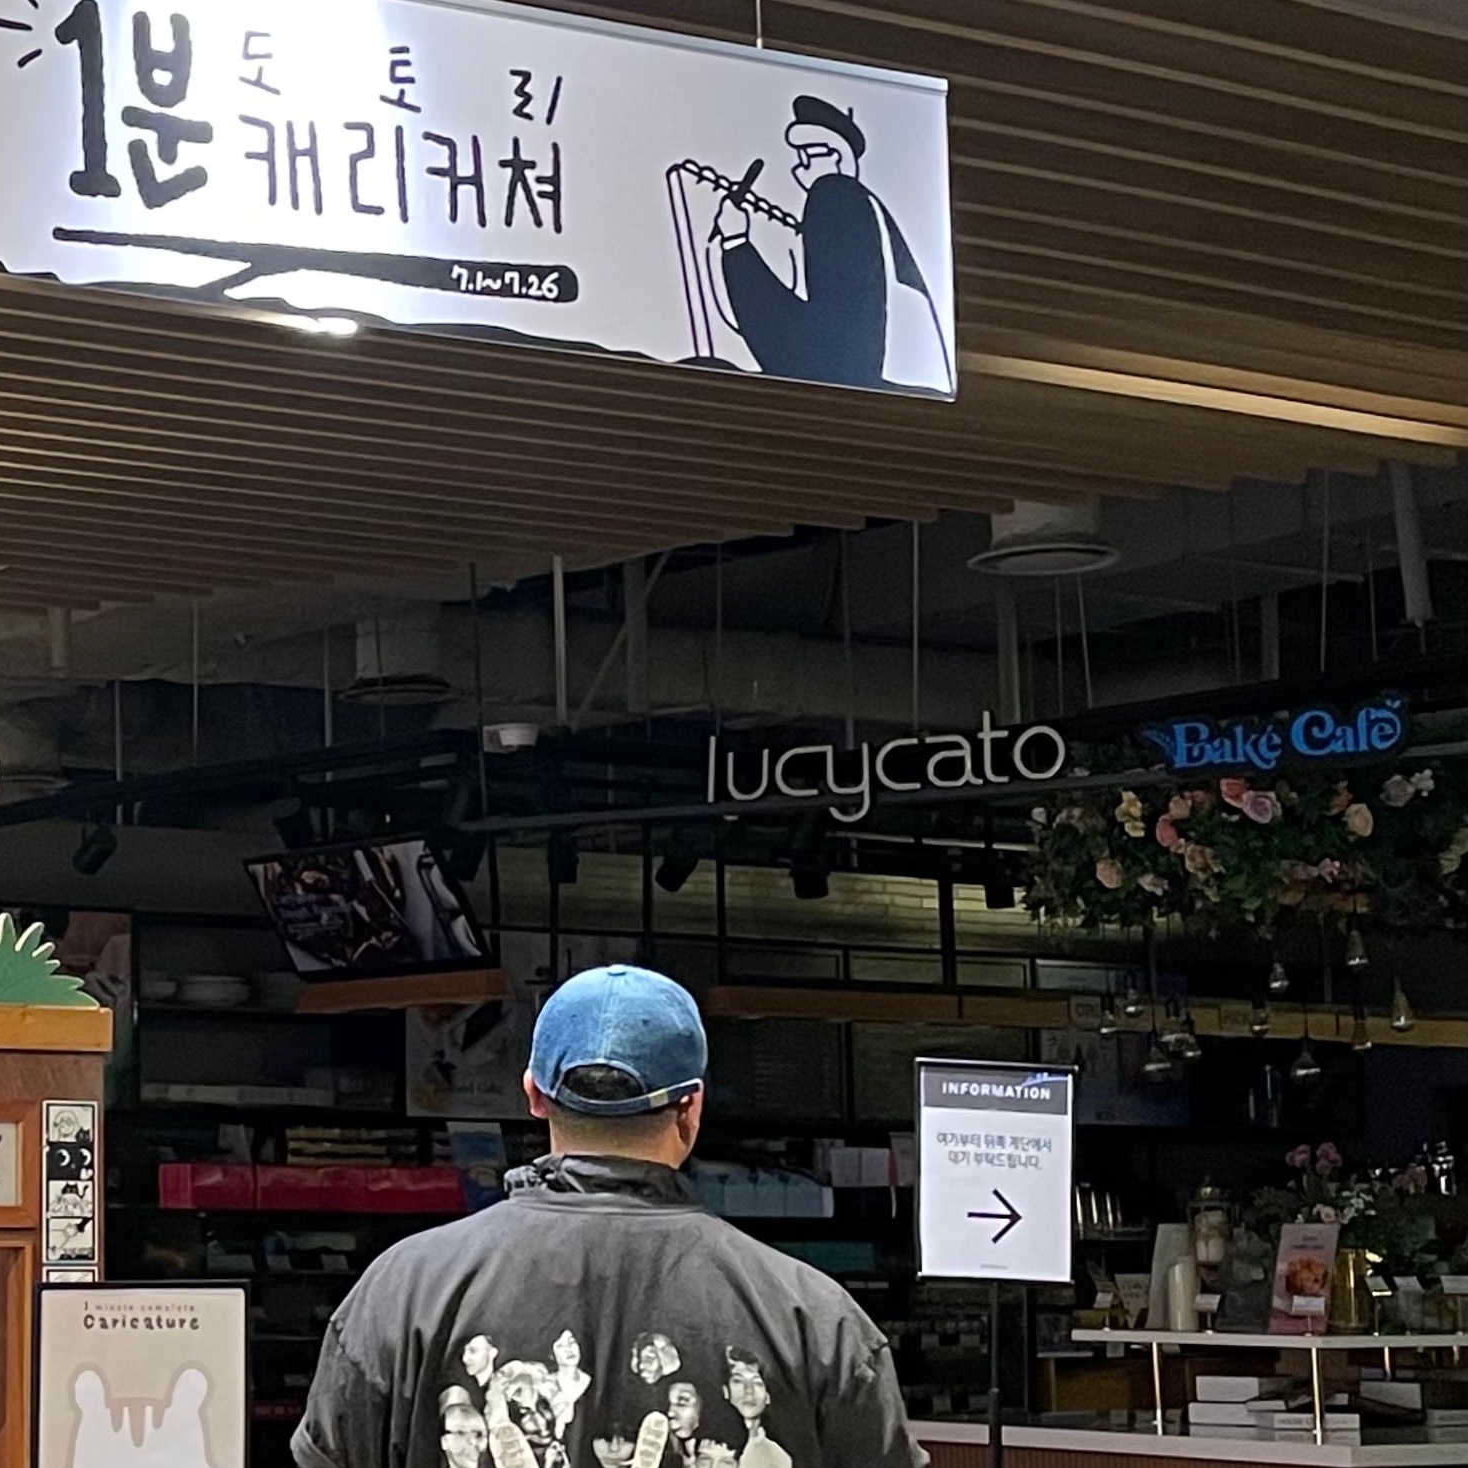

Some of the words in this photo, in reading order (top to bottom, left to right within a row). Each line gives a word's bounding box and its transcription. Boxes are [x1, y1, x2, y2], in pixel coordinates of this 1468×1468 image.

[54, 0, 214, 209] 1분
[238, 30, 563, 126] 도토리
[238, 113, 564, 234] 캐리커쳐
[450, 264, 561, 299] 7.1~7.26
[708, 709, 1067, 824] lucycato
[942, 1081, 1052, 1100] INFORMATION
[936, 1132, 982, 1149] 여기부터
[83, 1313, 200, 1331] Caricature
